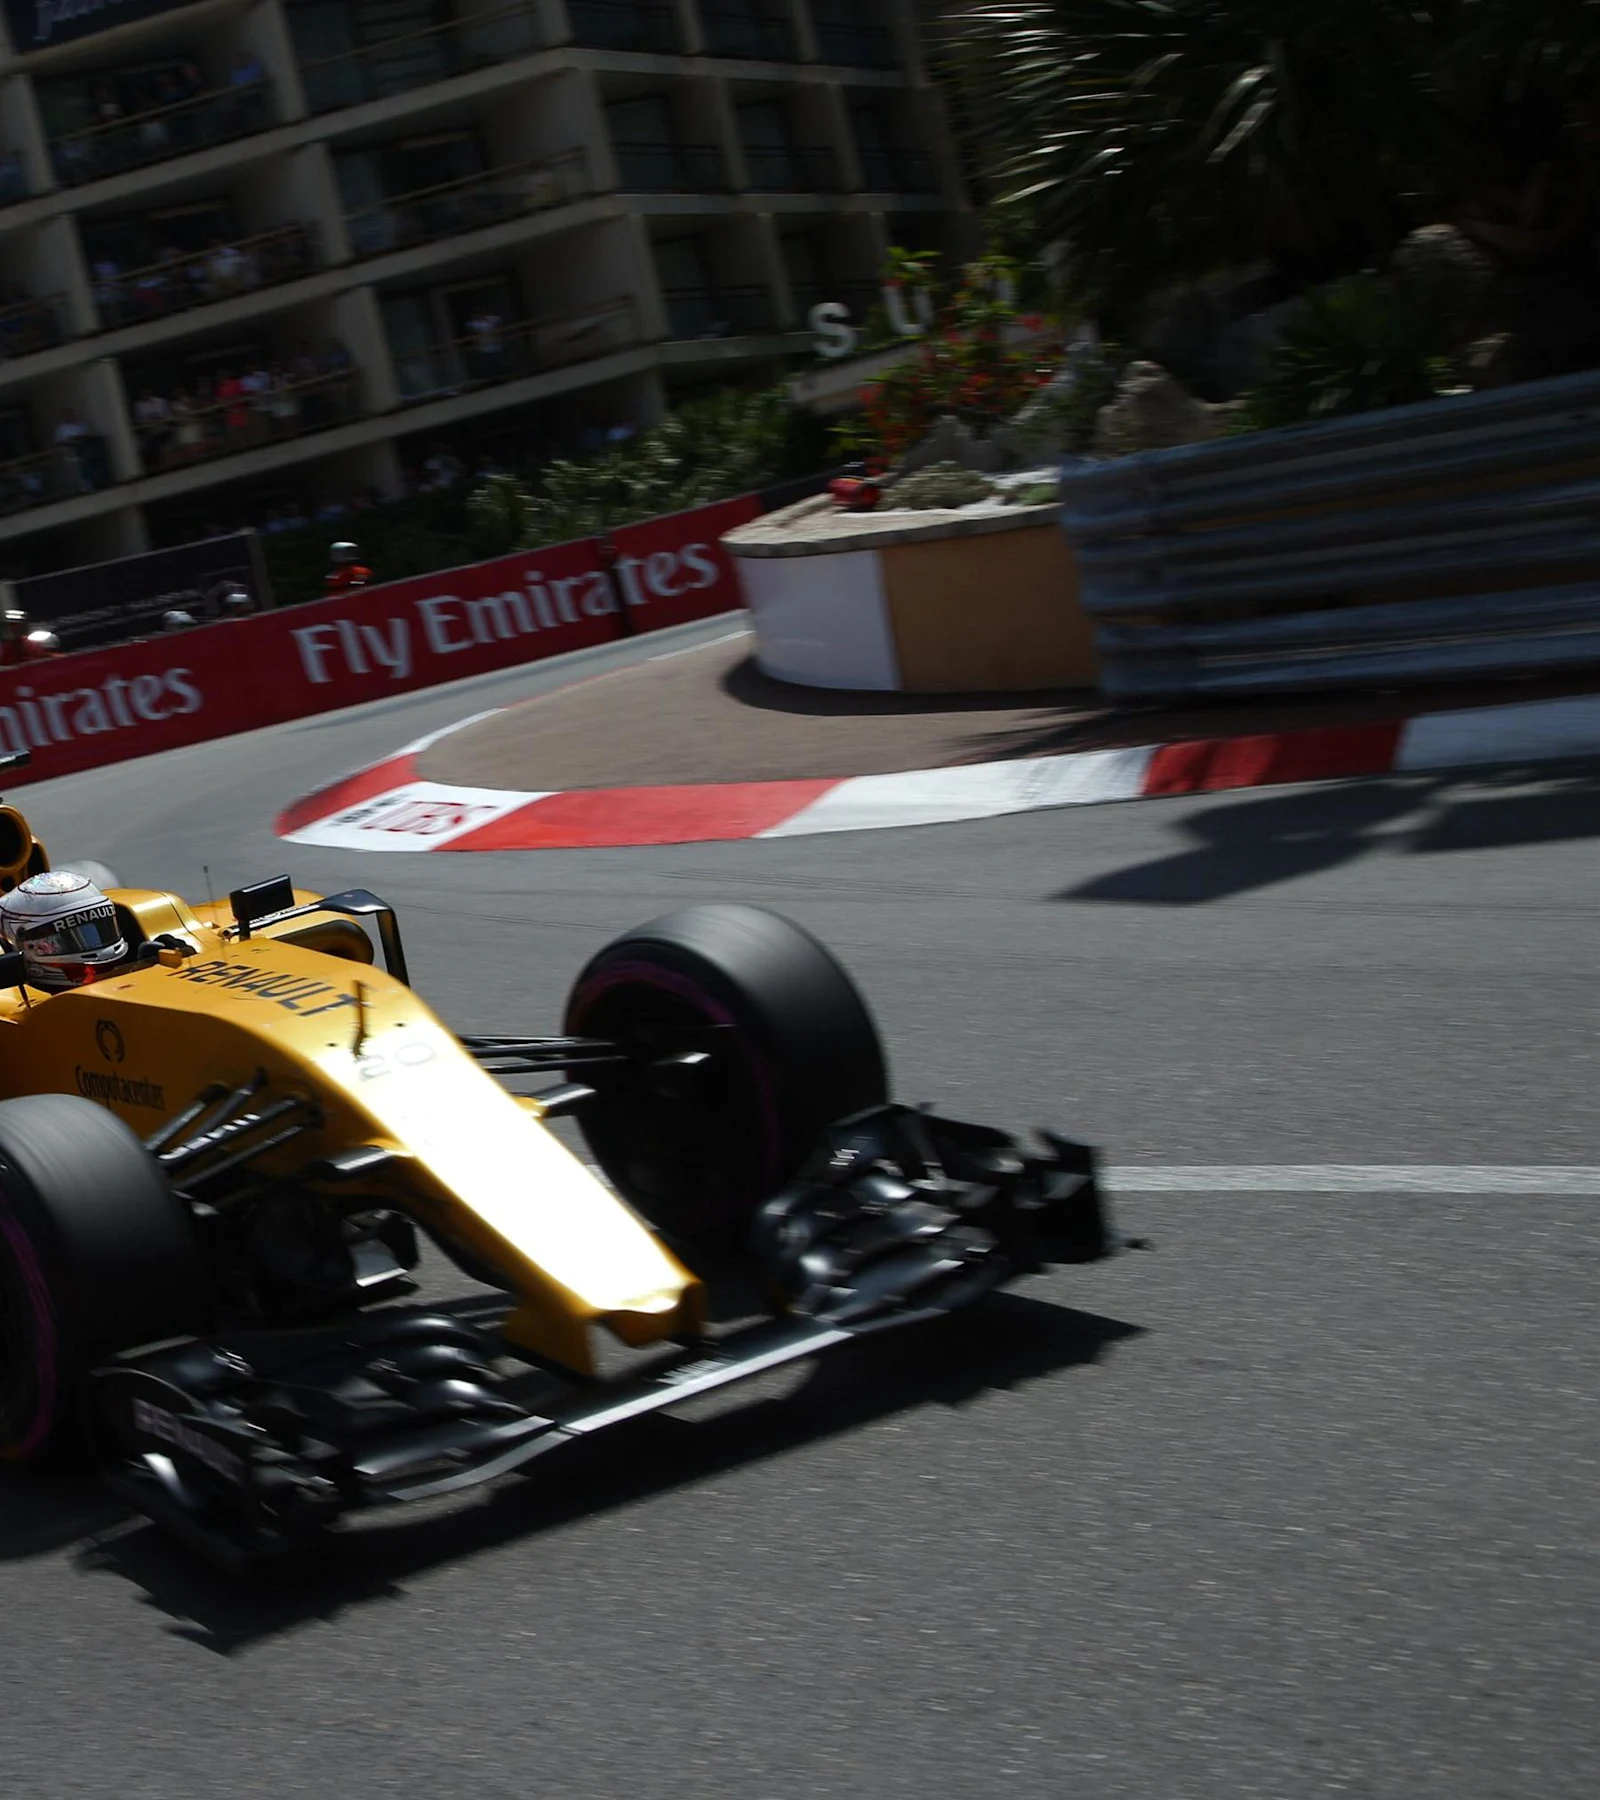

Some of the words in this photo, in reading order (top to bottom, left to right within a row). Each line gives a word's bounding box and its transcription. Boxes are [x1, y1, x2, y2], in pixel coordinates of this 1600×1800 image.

[291, 617, 413, 685] Fly
[413, 542, 721, 655] Emirates
[52, 904, 116, 933] RENAULT
[167, 960, 357, 1017] RENAULT
[74, 1064, 167, 1111] Computacenter
